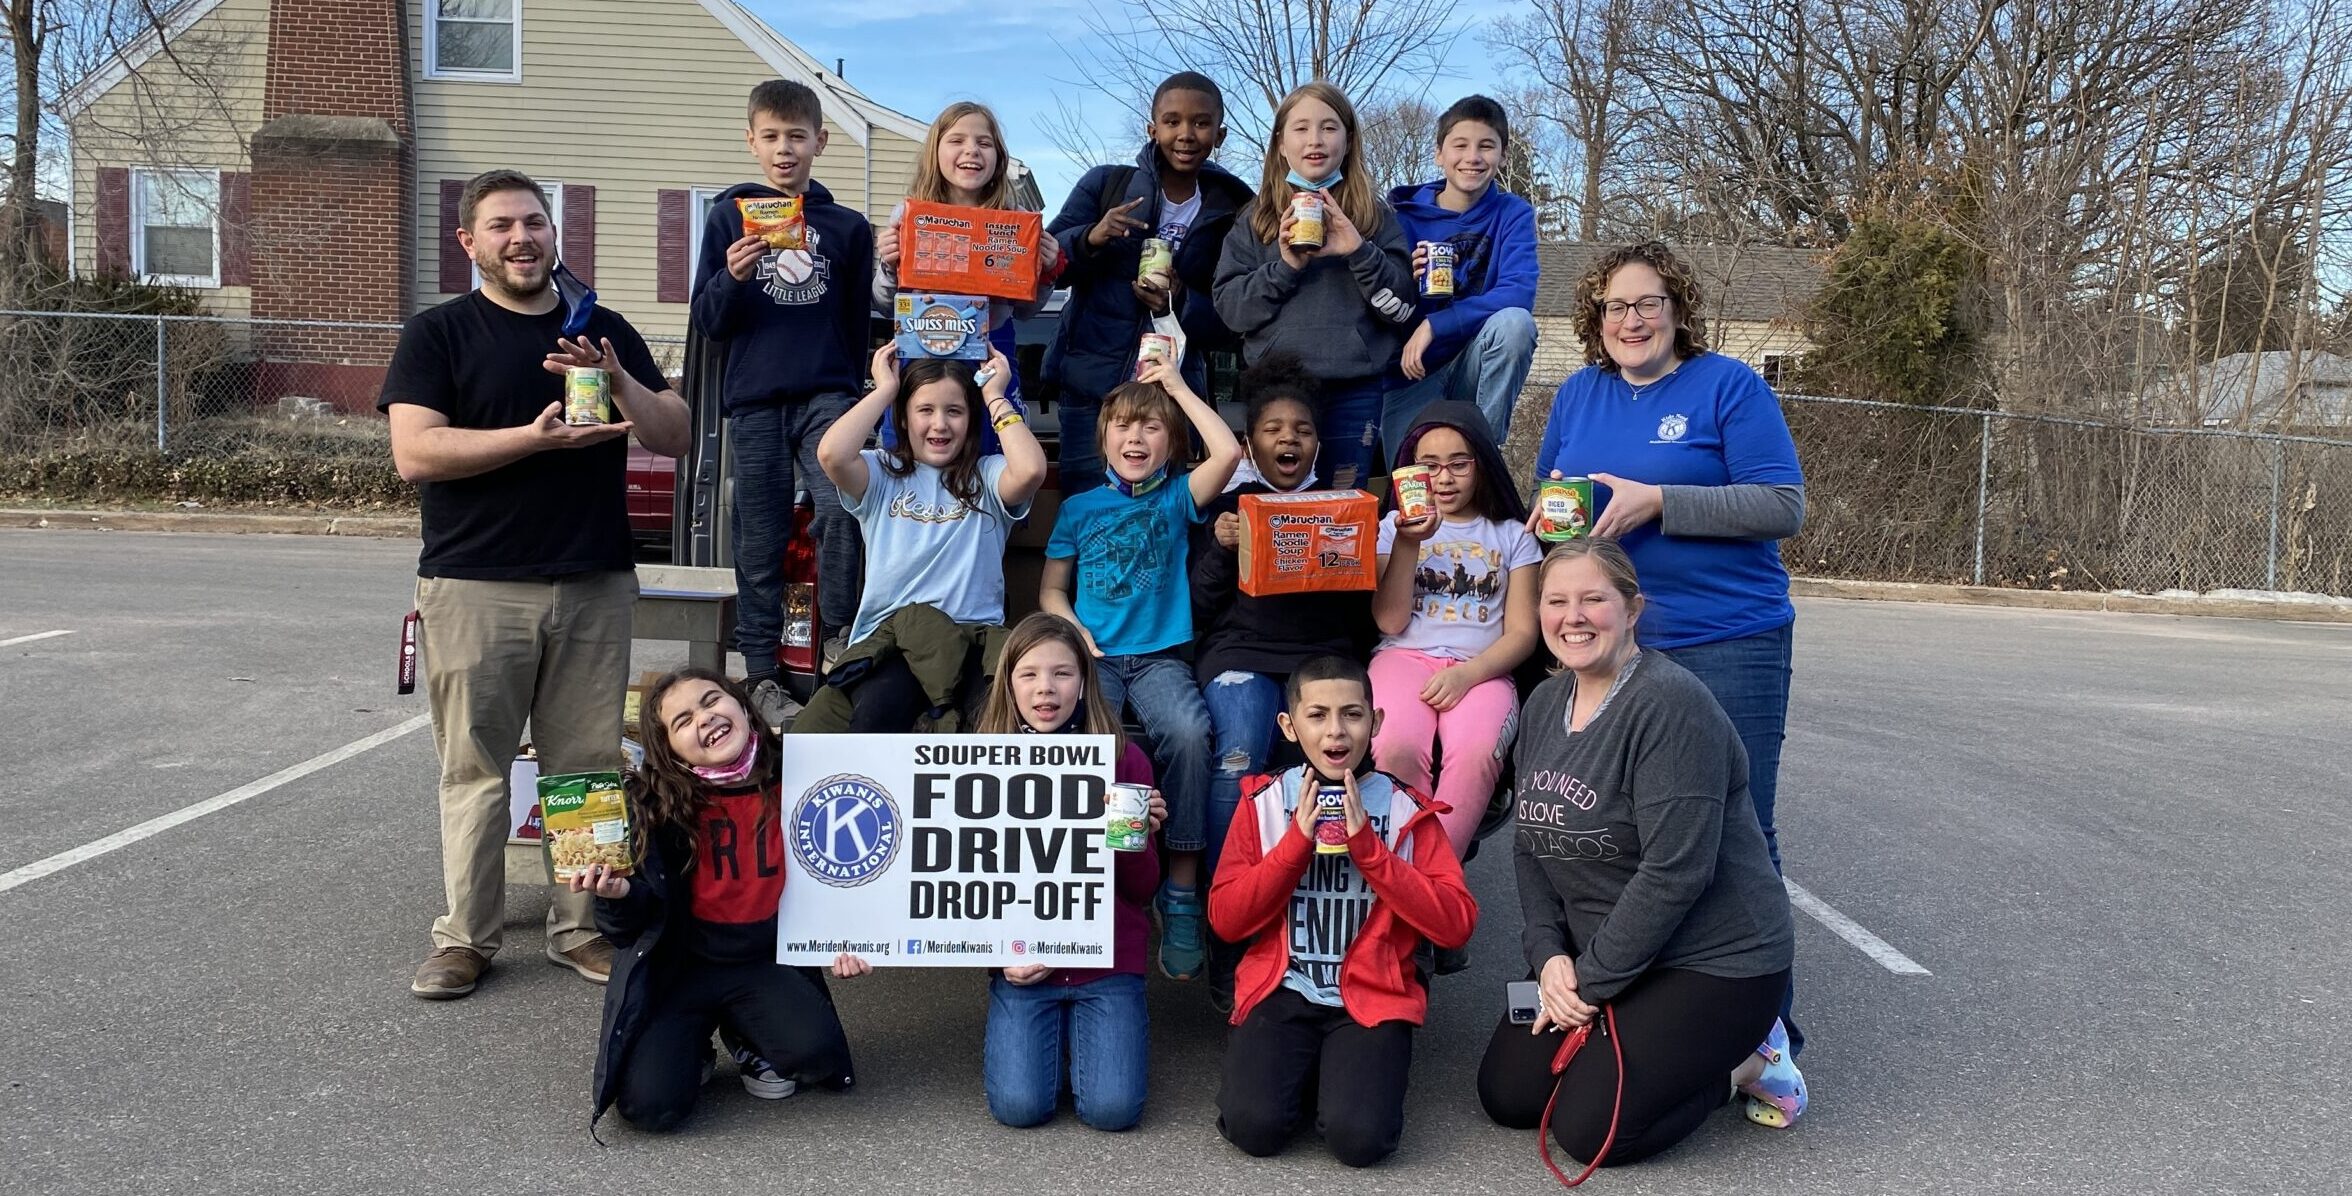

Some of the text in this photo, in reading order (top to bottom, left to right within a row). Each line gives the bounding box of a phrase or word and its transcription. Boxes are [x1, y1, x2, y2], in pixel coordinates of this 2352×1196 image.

[925, 216, 971, 229] Maruchan
[985, 222, 1021, 230] Instant
[972, 243, 1027, 254] Noodle Soup
[984, 254, 995, 267] 6
[762, 280, 828, 302] LITTLE LEAGUE
[1282, 515, 1333, 525] Maruchan
[1273, 530, 1309, 538] Ramen
[1273, 538, 1309, 547] Noodle
[1278, 547, 1304, 556] Soup
[1274, 557, 1308, 565] Chicken
[1318, 552, 1339, 567] 12
[1278, 564, 1304, 572] Flavor
[914, 744, 1107, 766] SOUPER BOWL
[811, 784, 883, 809] KIWANIS
[912, 772, 1106, 820] FOOD
[1554, 773, 1597, 811] NEED
[546, 794, 585, 806] Knorr
[1317, 794, 1343, 807] GOY
[1529, 801, 1565, 826] LOVE
[823, 799, 870, 862] K
[706, 815, 779, 881] RL
[800, 820, 893, 877] INTERNATIONAL
[910, 826, 1106, 874] DRIVE
[1297, 853, 1350, 893] ING
[909, 880, 1105, 921] DROP-OFF
[1289, 895, 1373, 956] ENIU
[786, 939, 890, 955] www.MeridenKiwanis.org
[1028, 940, 1104, 955] @MeridenKiwanis
